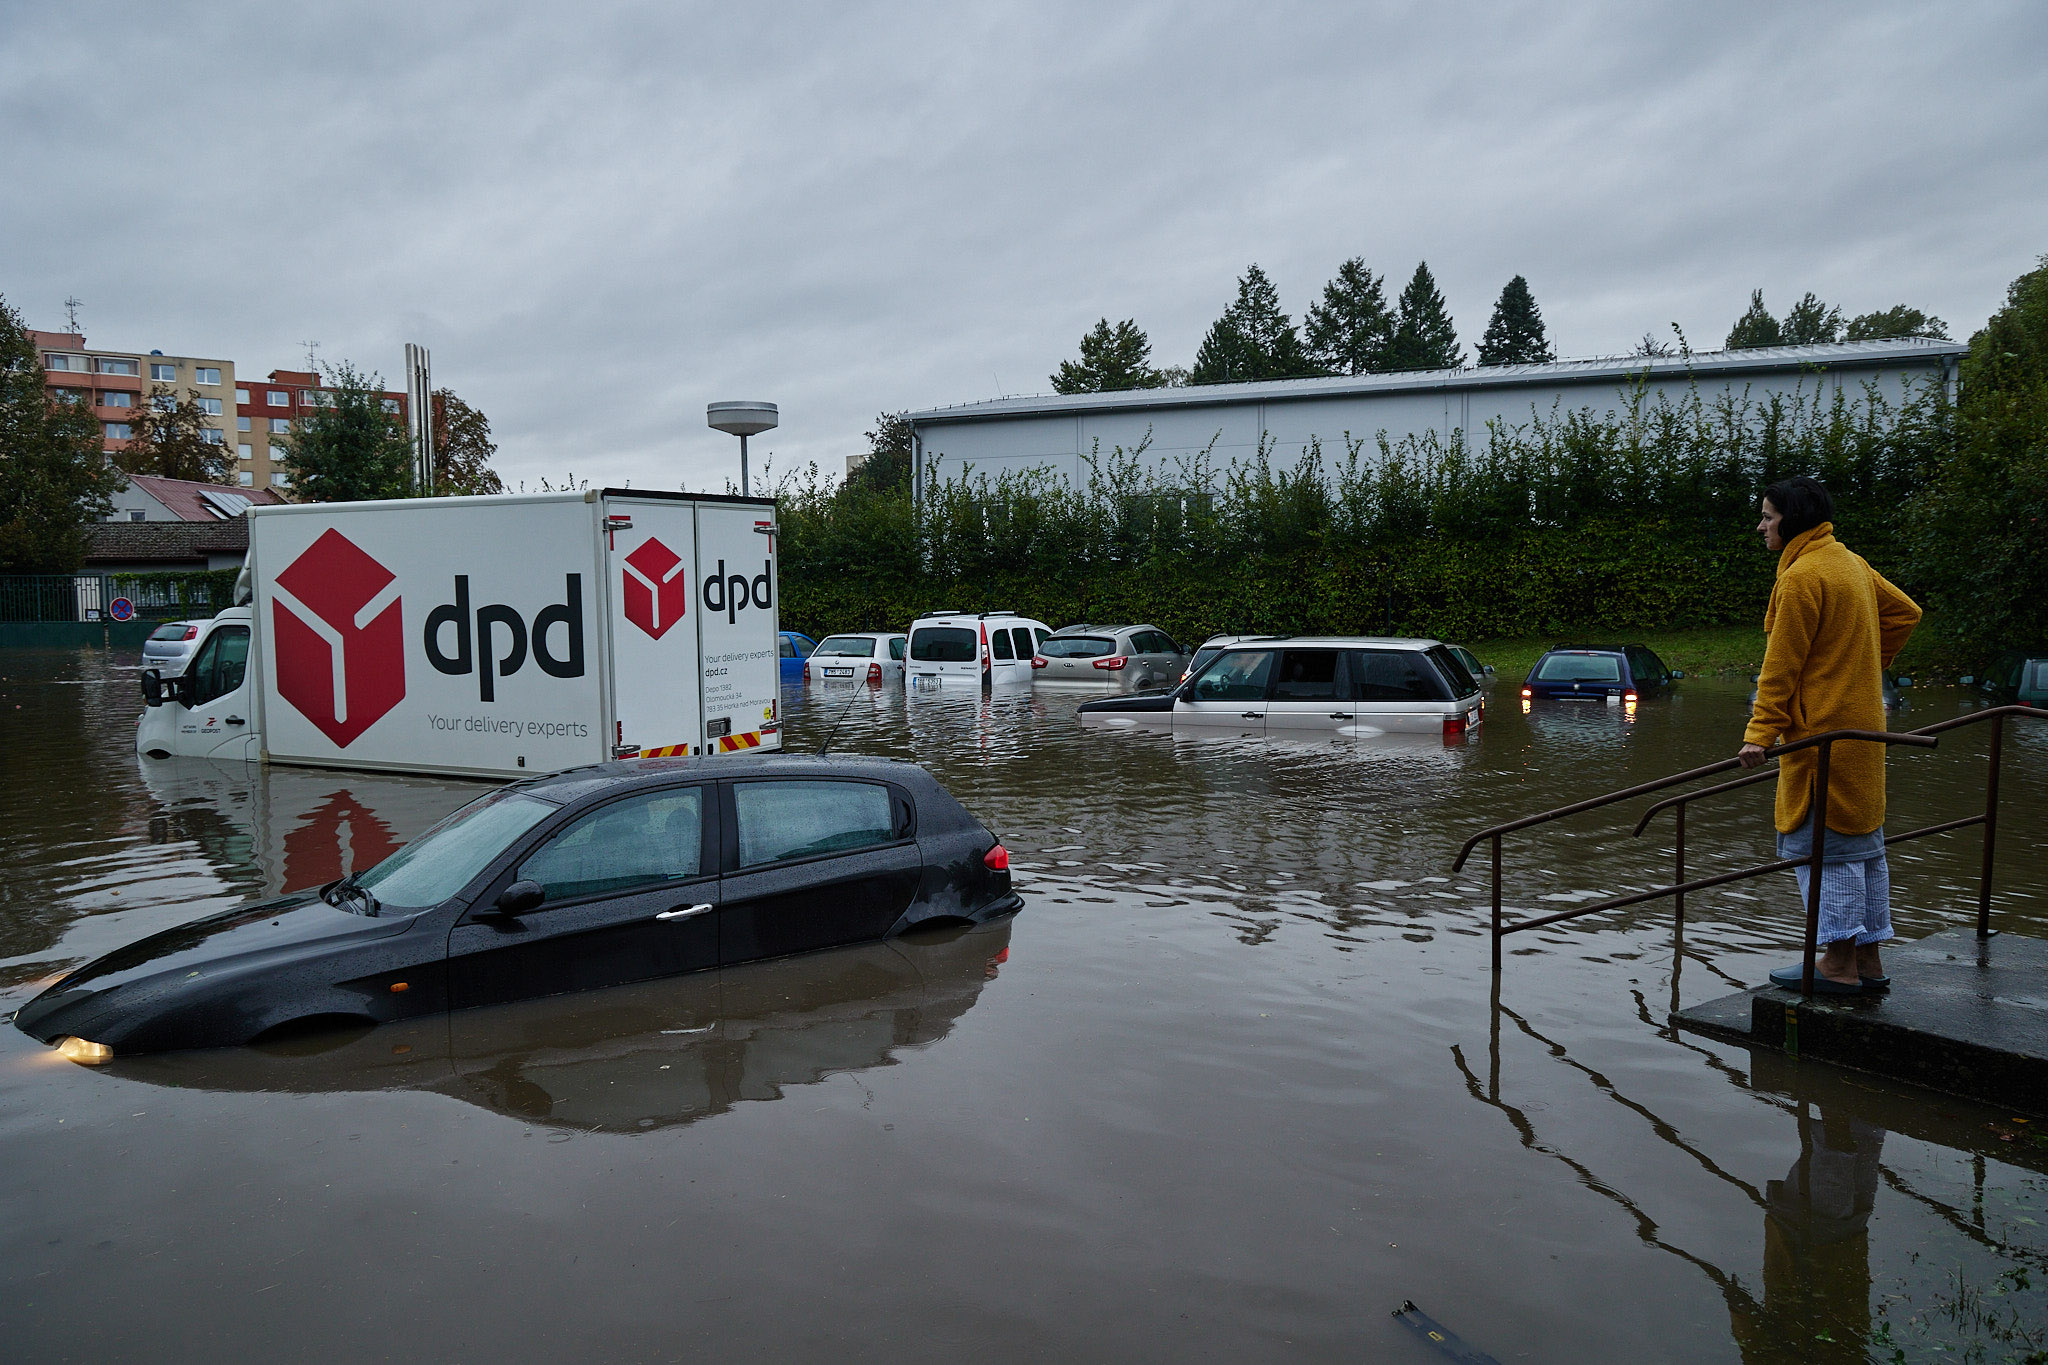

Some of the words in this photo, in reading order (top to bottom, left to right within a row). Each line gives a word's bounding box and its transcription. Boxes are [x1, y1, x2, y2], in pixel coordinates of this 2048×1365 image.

[703, 560, 772, 624] dpd
[424, 573, 585, 702] dpd
[705, 655, 721, 664] Your
[722, 652, 749, 662] delivery
[750, 650, 774, 660] experts
[705, 667, 728, 678] dpd.cz
[705, 686, 719, 694] Depo
[428, 714, 461, 731] Your
[464, 716, 524, 738] delivery
[527, 721, 588, 739] experts
